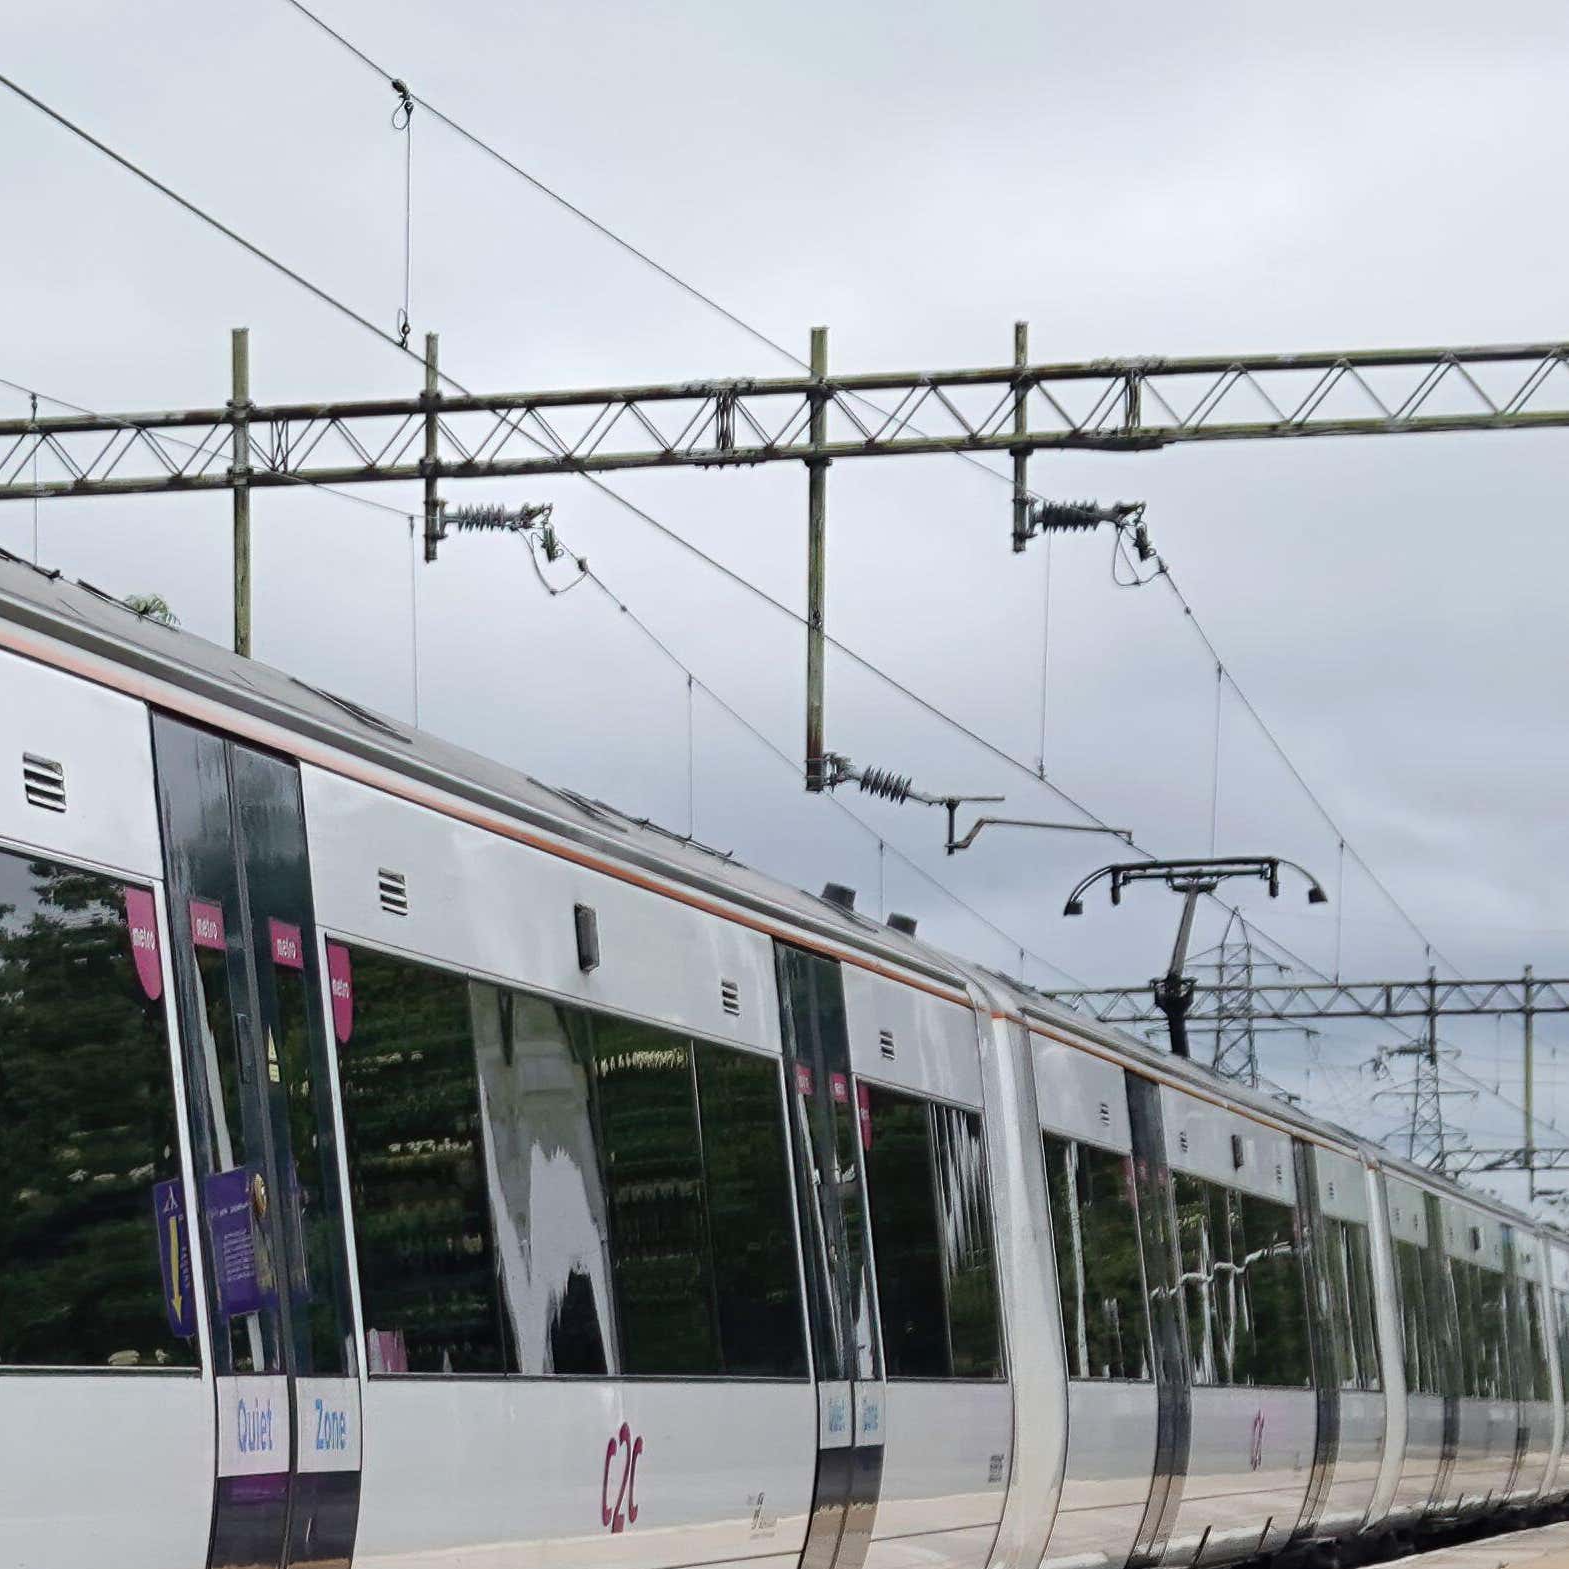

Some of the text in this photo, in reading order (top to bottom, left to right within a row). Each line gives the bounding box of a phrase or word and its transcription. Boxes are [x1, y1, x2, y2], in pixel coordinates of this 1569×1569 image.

[131, 927, 155, 950] metro
[196, 918, 218, 941] metro
[276, 937, 297, 960] metro
[332, 977, 350, 999] metro
[238, 1397, 347, 1453] Quiet Zone
[602, 1421, 643, 1534] c2c
